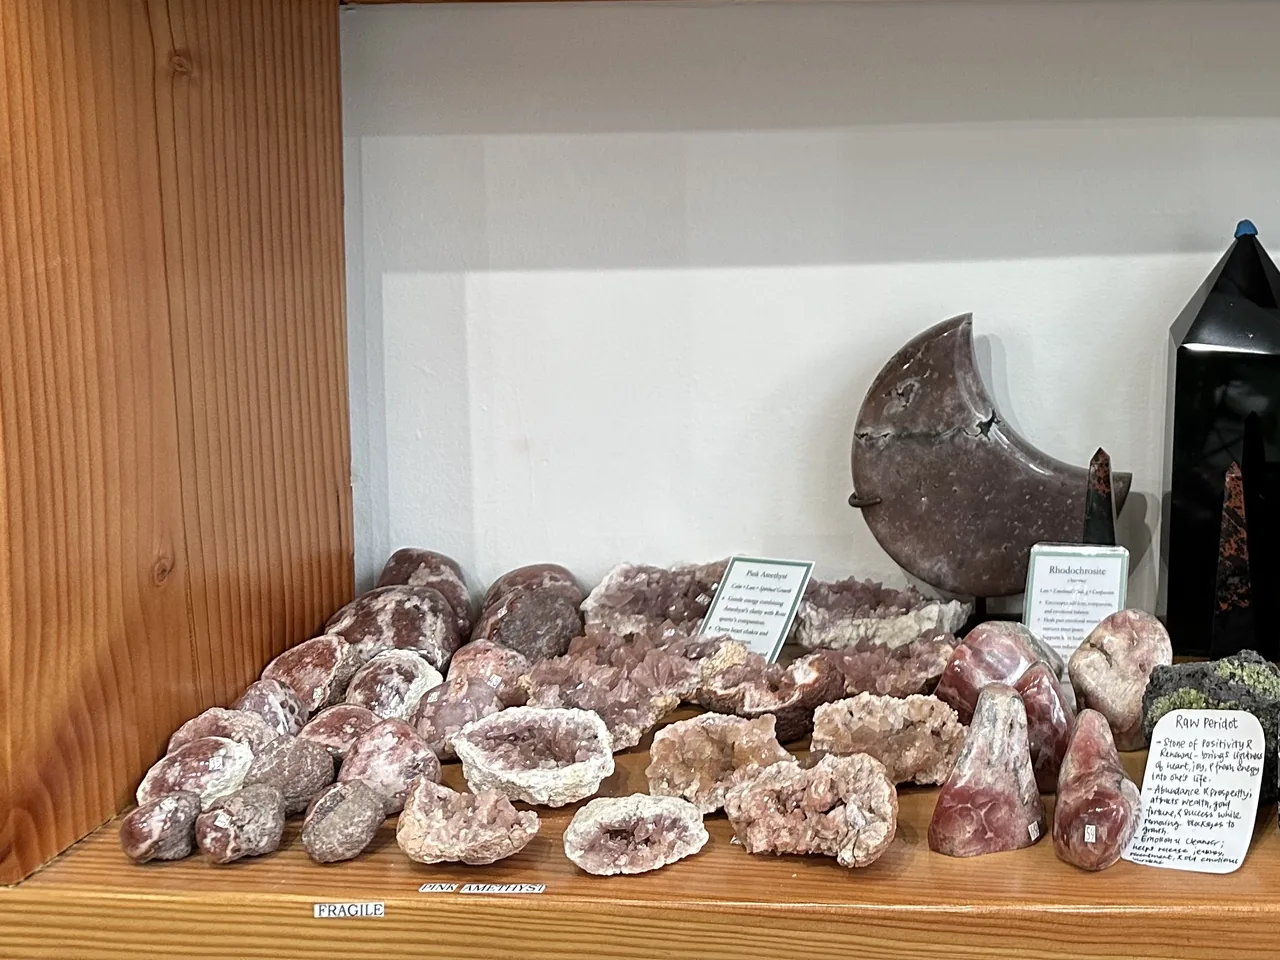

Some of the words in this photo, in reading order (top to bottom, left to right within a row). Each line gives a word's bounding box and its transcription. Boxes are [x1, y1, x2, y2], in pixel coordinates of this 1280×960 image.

[1049, 565, 1106, 575] Rhodochrosite
[760, 571, 788, 581] Amethyst
[1175, 714, 1200, 729] Raw
[1203, 717, 1239, 730] Peridot
[1163, 738, 1186, 749] Stone
[1188, 739, 1198, 752] of
[1201, 750, 1229, 763] brings
[1233, 751, 1263, 764] lightness
[1214, 762, 1235, 775] fresh
[1152, 771, 1167, 781] into
[1154, 785, 1200, 796] Abundance
[1150, 796, 1179, 805] attracts
[421, 883, 458, 891] PINK
[462, 883, 546, 892] AMETHYST
[318, 904, 384, 917] FRAGILE
